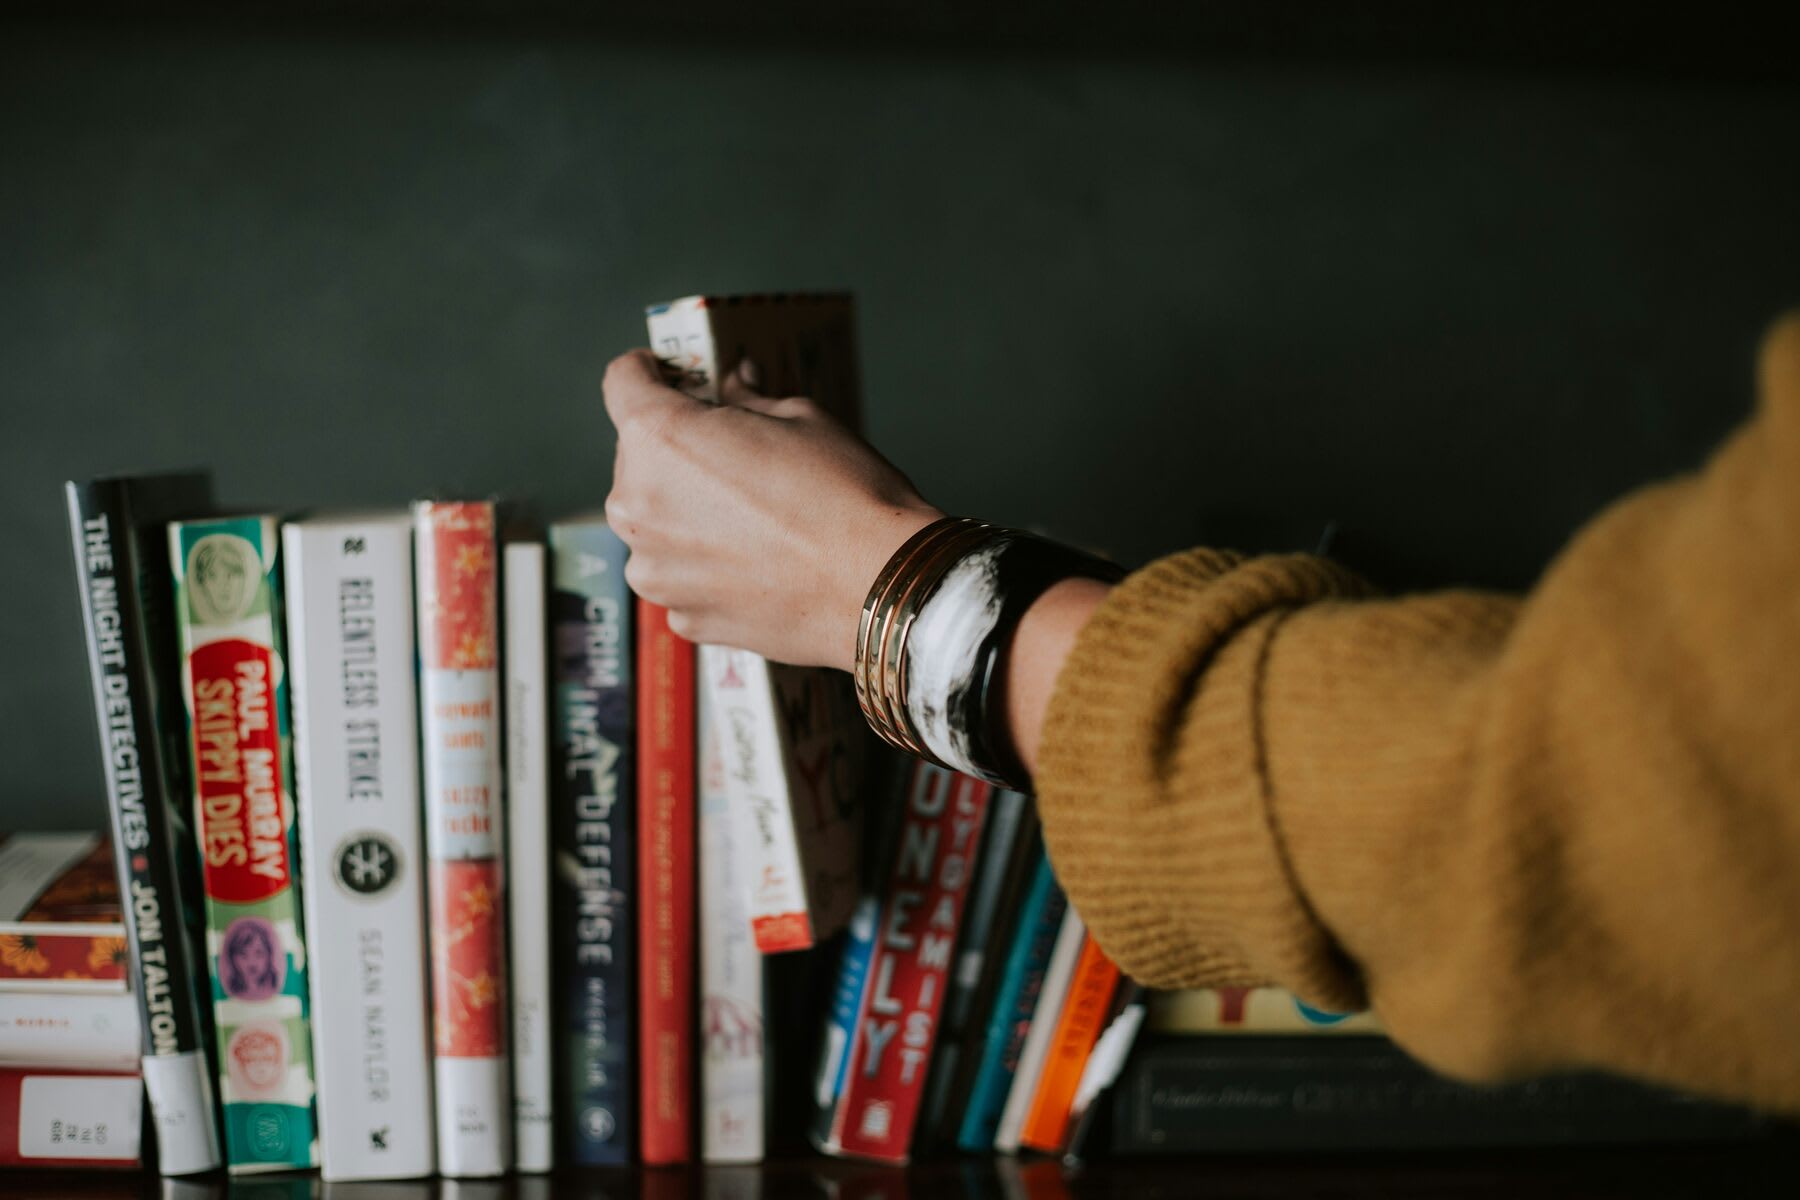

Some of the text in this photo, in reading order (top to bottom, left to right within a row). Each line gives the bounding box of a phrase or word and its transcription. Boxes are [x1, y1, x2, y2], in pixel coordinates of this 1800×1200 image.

[577, 552, 609, 579] A
[84, 512, 150, 850] THE NIGHT DETECTIVES
[196, 677, 248, 867] SKIPPY DIES
[234, 659, 285, 880] PAUL MURRAY
[340, 577, 383, 801] RELENTLESS STRIKE
[131, 880, 179, 1057] JON TALTON
[575, 796, 613, 965] DEFENSE
[359, 927, 390, 1102] SEAN NAYLOR
